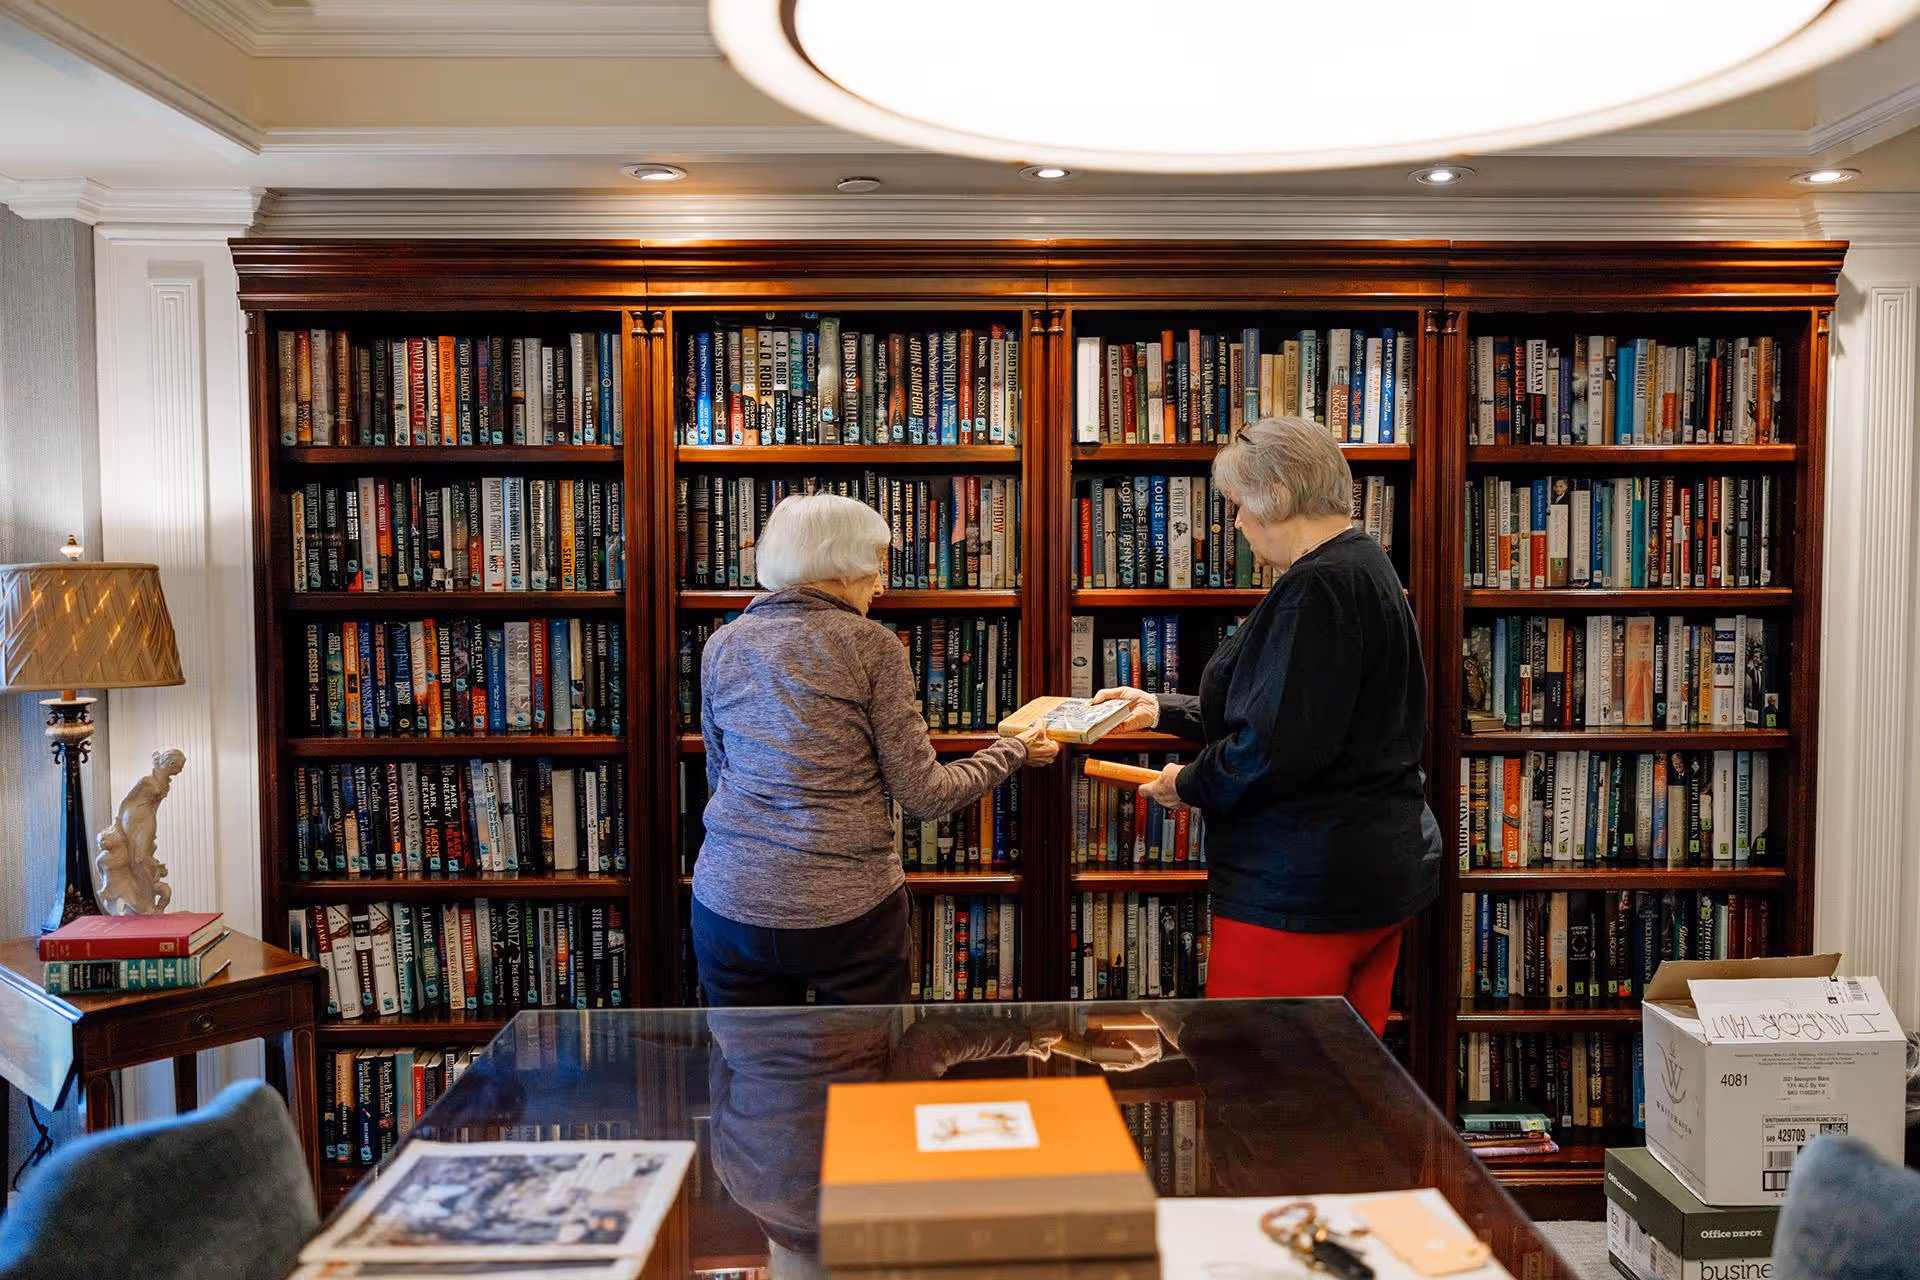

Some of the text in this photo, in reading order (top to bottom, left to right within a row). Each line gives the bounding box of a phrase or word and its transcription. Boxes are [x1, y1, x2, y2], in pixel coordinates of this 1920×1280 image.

[512, 342, 521, 388] ALEX BERENSON
[715, 332, 724, 403] JAMES PATTERSON
[760, 341, 771, 396] J. D. ROBB
[776, 349, 785, 358] D.
[807, 357, 815, 382] ROBB
[844, 341, 855, 392] ROBINSON
[878, 344, 887, 369] SUSPECT
[943, 335, 957, 401] SIDNEY SHELDON
[1008, 344, 1017, 391] BRAD THOR
[1535, 343, 1543, 393] TOM CLANCY
[393, 342, 404, 401] DAVID BALDACCI
[412, 341, 425, 419] DAVID BALDACCI
[460, 344, 469, 401] DAVID BALDACCI
[744, 360, 755, 390] ROBB
[776, 361, 786, 385] ROBB
[910, 338, 922, 415] JOHN SANDFORD
[1516, 347, 1525, 401] BAD BLOOD
[557, 400, 565, 423] SWITCH
[805, 395, 811, 403] TO
[993, 391, 1001, 426] BACKLASH
[1332, 389, 1340, 425] MOORE
[1340, 395, 1348, 419] BETH
[592, 484, 600, 502] CLIVE
[1094, 483, 1102, 501] JODI
[1353, 484, 1362, 517] RIVERS
[1666, 480, 1674, 517] COUNTDOWN
[1740, 479, 1748, 498] Killing
[469, 488, 479, 536] STEPHEN COONTS
[490, 481, 502, 552] PATRICIA CORNWELL
[510, 482, 520, 576] PATRICIA CORNWELL SCARPETTA
[905, 484, 914, 542] STUART WOODS
[993, 496, 1004, 533] WIDOW
[1121, 481, 1132, 568] LOUISE PENNY
[1138, 484, 1147, 567] LOUISE PENNY
[489, 555, 497, 572] MIST
[308, 625, 318, 682] CLIVE CUSSLER
[440, 627, 451, 683] JOSEPH FINDER
[474, 624, 483, 682] VINCE FLYNN
[535, 623, 544, 674] CLIVE CUSSLER
[597, 624, 606, 656] ALAN FURST
[443, 689, 451, 699] THE
[370, 767, 380, 811] Sue Grafton
[387, 766, 399, 822] SUE GRAFTON
[422, 776, 430, 815] GREANEY
[1559, 787, 1570, 842] REAGAN
[317, 924, 327, 950] JAMES
[401, 918, 409, 929] D.
[423, 919, 432, 943] JANCE
[507, 903, 520, 946] KOONTZ
[526, 915, 534, 948] LESCROART
[592, 908, 602, 960] STEVE MARTINI
[959, 918, 967, 935] Water
[1128, 904, 1138, 937] WEYWARD
[1463, 914, 1472, 934] Help
[402, 931, 413, 962] JAMES
[461, 913, 474, 972] JONATHAN KELLERMAN
[449, 943, 457, 978] WOBEGON
[559, 962, 567, 985] POISON
[958, 948, 967, 977] Elephants
[512, 979, 520, 997] TAKING
[384, 1062, 392, 1081] Robert
[1720, 1074, 1748, 1087] 4081
[384, 1092, 394, 1117] Parker's
[1778, 1129, 1805, 1142] 429709
[1608, 1172, 1623, 1190] Office
[1701, 1230, 1762, 1239] Office DEPOT
[1700, 1260, 1772, 1280] busine
